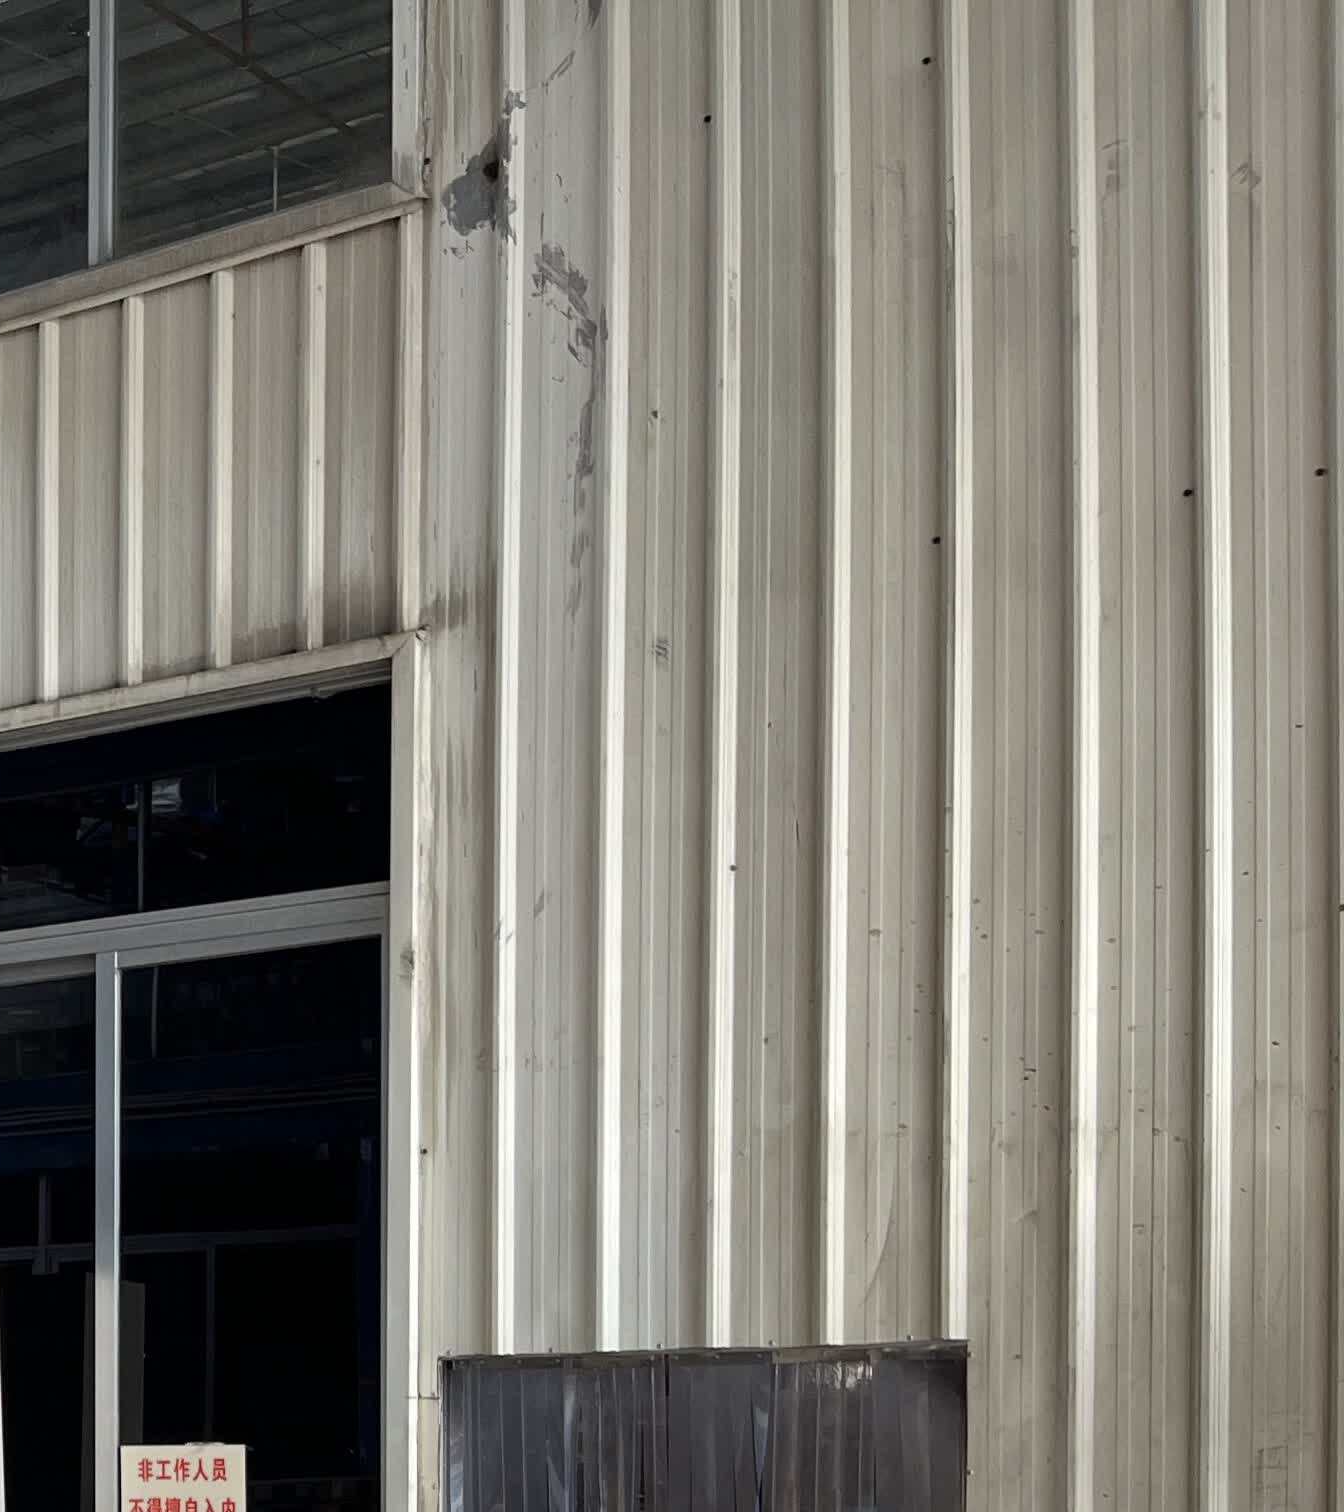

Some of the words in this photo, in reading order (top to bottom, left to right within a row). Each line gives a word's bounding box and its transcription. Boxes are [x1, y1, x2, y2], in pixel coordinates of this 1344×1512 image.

[138, 1458, 227, 1482] 非工作人员
